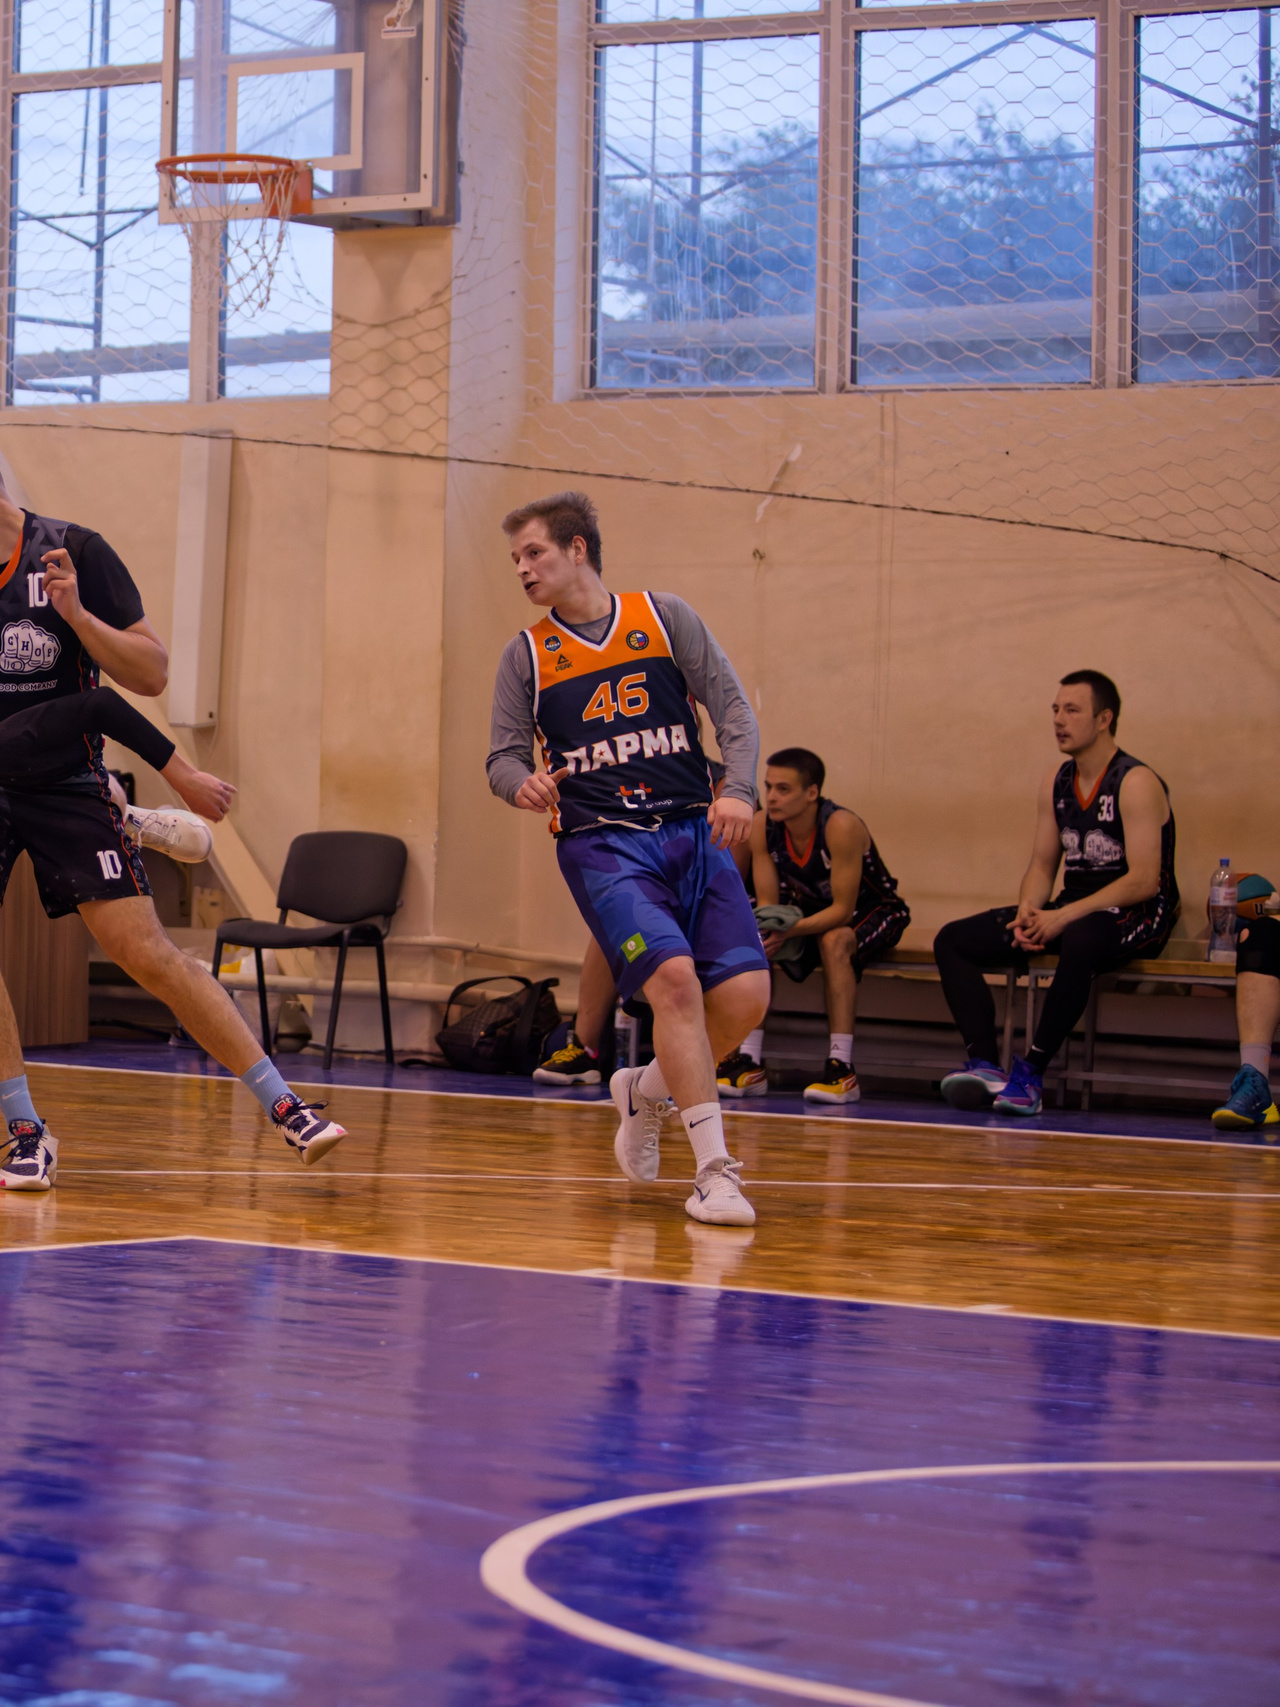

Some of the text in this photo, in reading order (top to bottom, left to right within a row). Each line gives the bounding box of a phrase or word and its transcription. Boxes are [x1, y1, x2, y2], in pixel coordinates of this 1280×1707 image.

[27, 572, 49, 608] 10
[555, 661, 573, 673] PEAK
[18, 679, 58, 692] COMPANY
[582, 671, 650, 724] 46
[562, 724, 691, 777] ПАРМА
[1097, 795, 1115, 822] 33
[96, 850, 122, 880] 10
